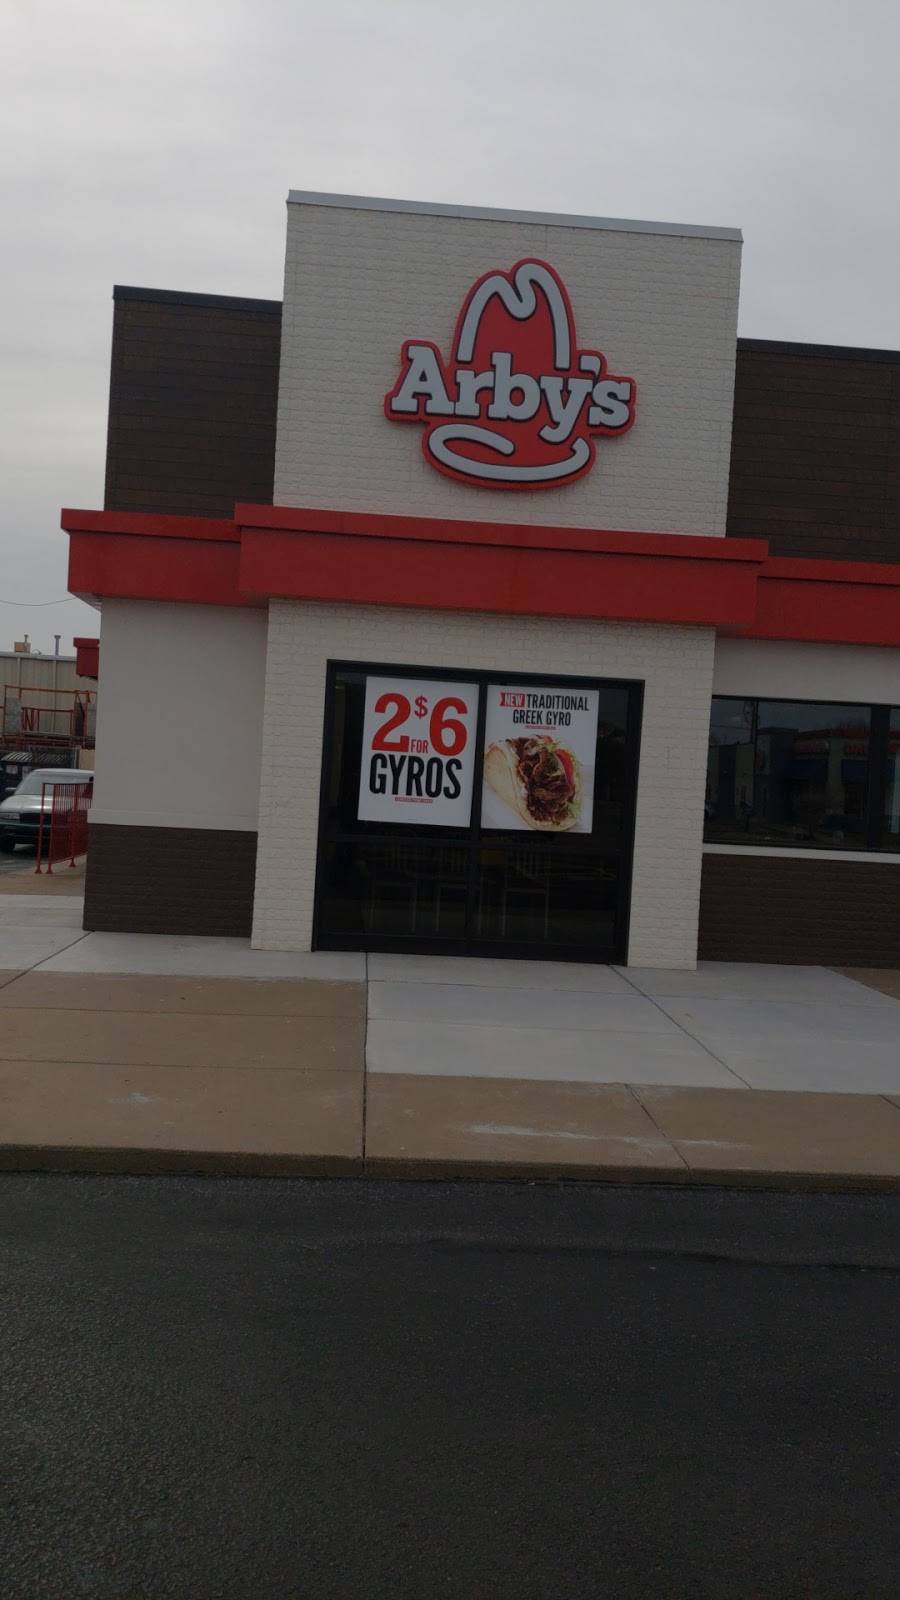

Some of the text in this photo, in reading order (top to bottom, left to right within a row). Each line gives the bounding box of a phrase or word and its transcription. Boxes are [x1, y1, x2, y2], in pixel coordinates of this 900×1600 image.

[392, 345, 631, 442] Arby's
[371, 692, 411, 753] 2
[411, 739, 428, 754] FOR
[504, 693, 589, 711] NEW TRADITIONAL
[512, 709, 571, 727] GREEK GYRO
[369, 753, 462, 800] GYROS
